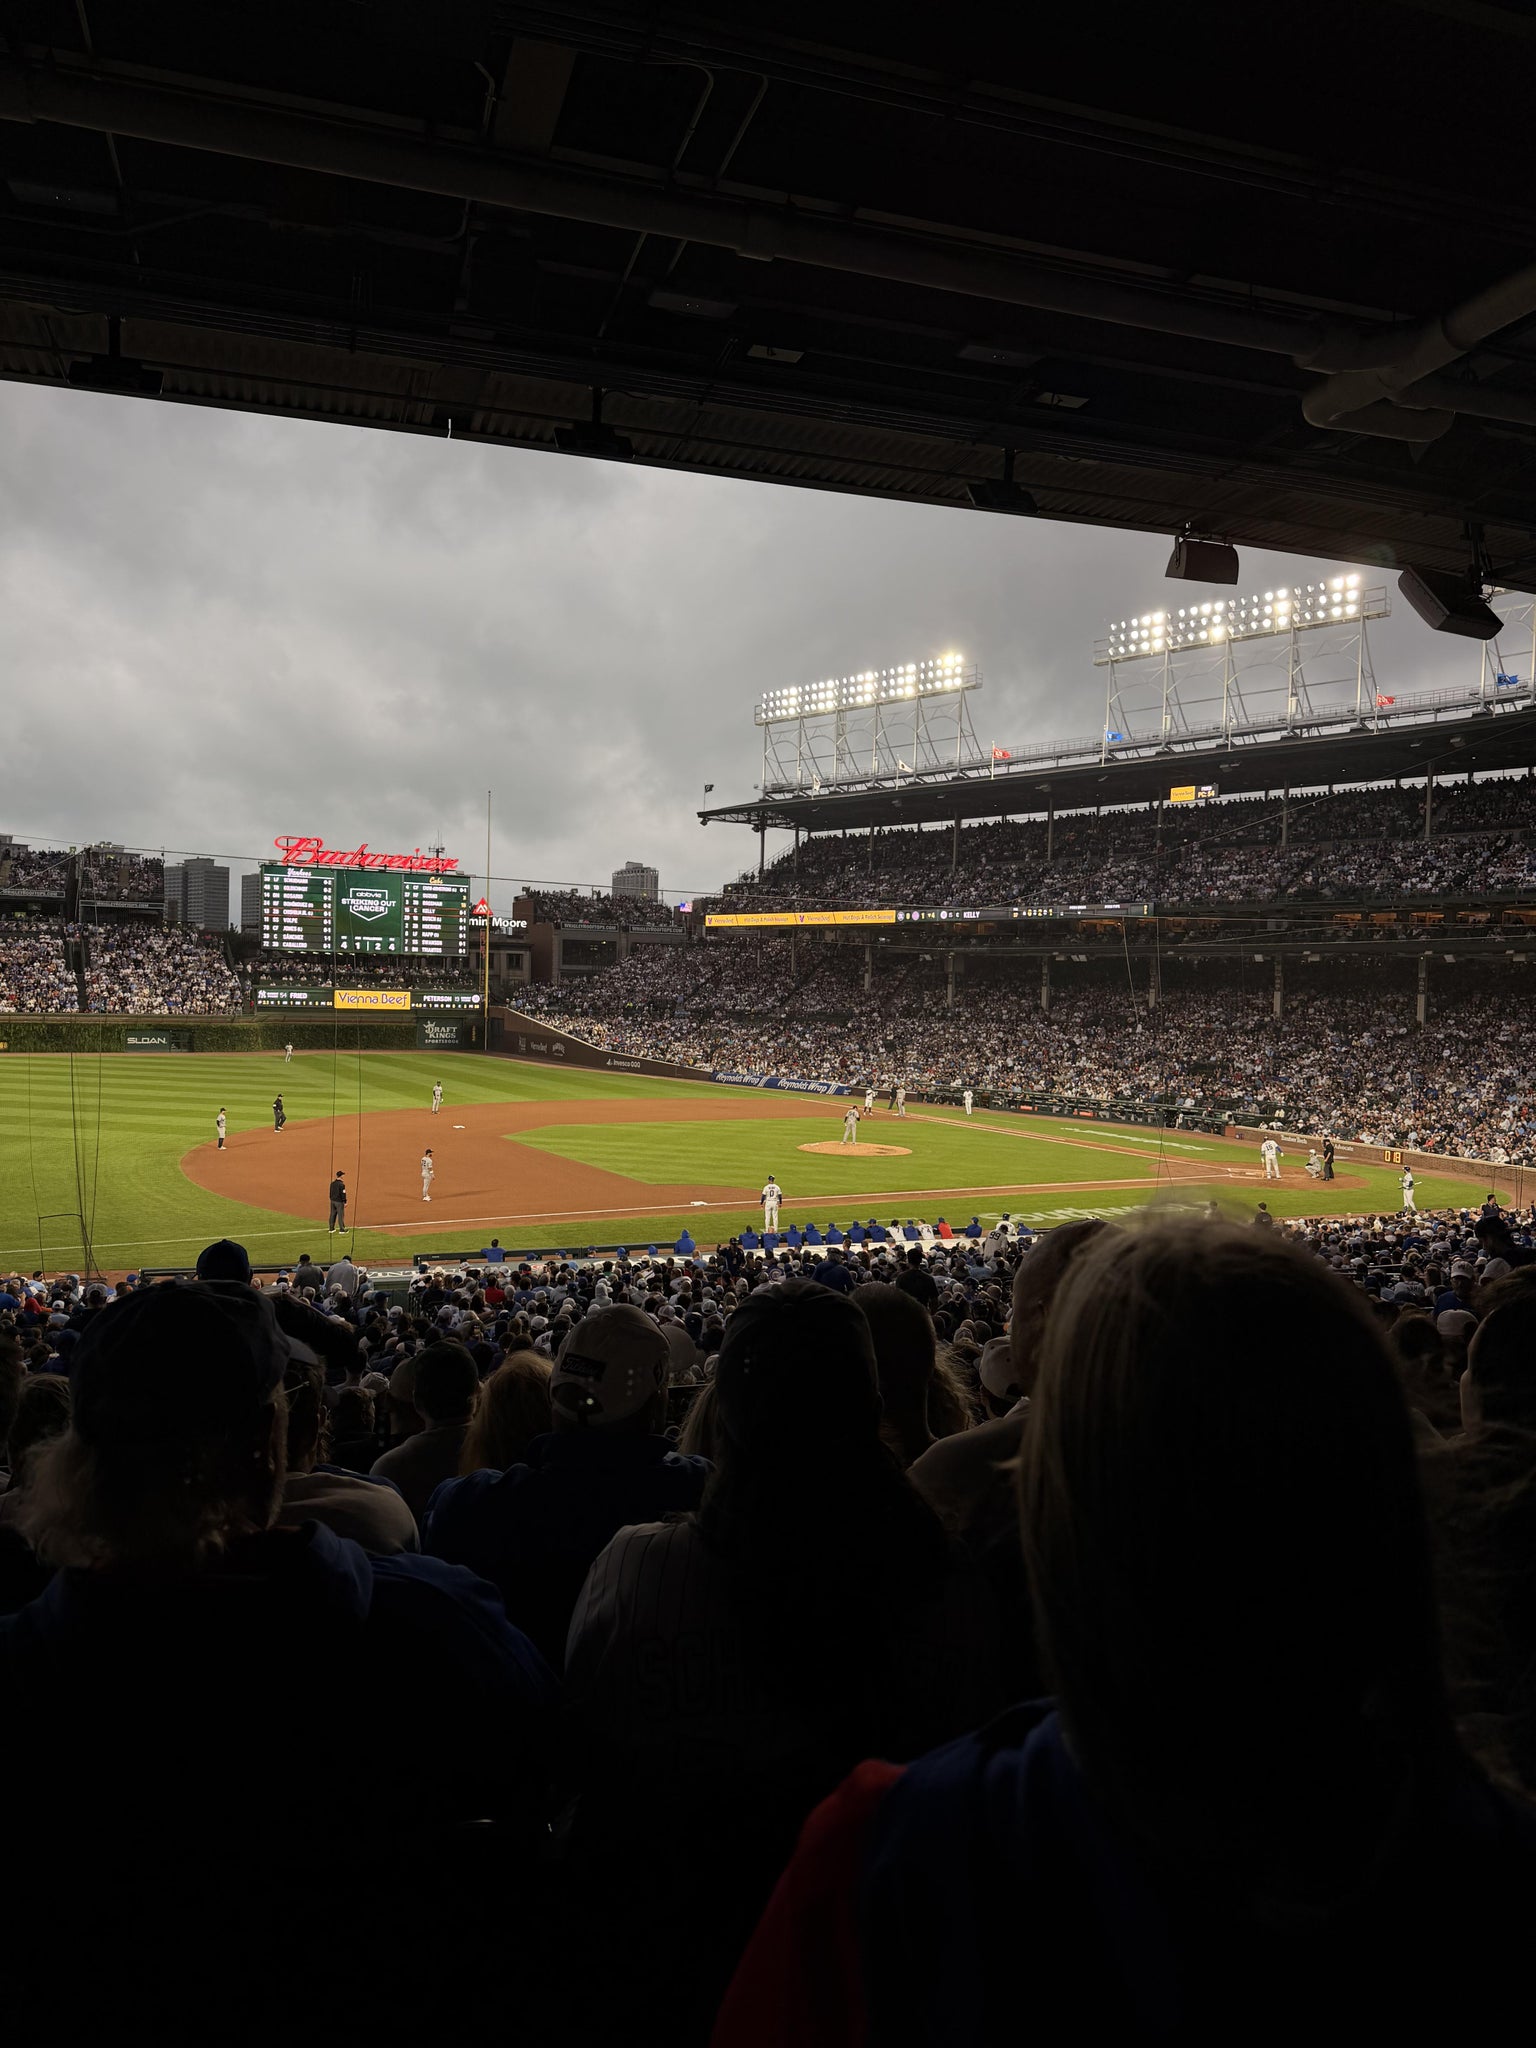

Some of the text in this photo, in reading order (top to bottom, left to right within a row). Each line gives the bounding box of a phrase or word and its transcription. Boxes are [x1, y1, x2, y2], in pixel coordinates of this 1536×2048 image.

[274, 835, 459, 872] Budweiser
[288, 868, 312, 877] Yankees
[492, 917, 527, 928] Moore
[338, 992, 407, 1007] Vienna Beef
[425, 1026, 457, 1034] DRAFT
[716, 1073, 760, 1084] Reynolds Wrap
[778, 1078, 828, 1092] Reynolds Wrap
[1334, 1144, 1354, 1152] Advocate
[1384, 1150, 1400, 1163] 0 18
[989, 1232, 1001, 1241] 99
